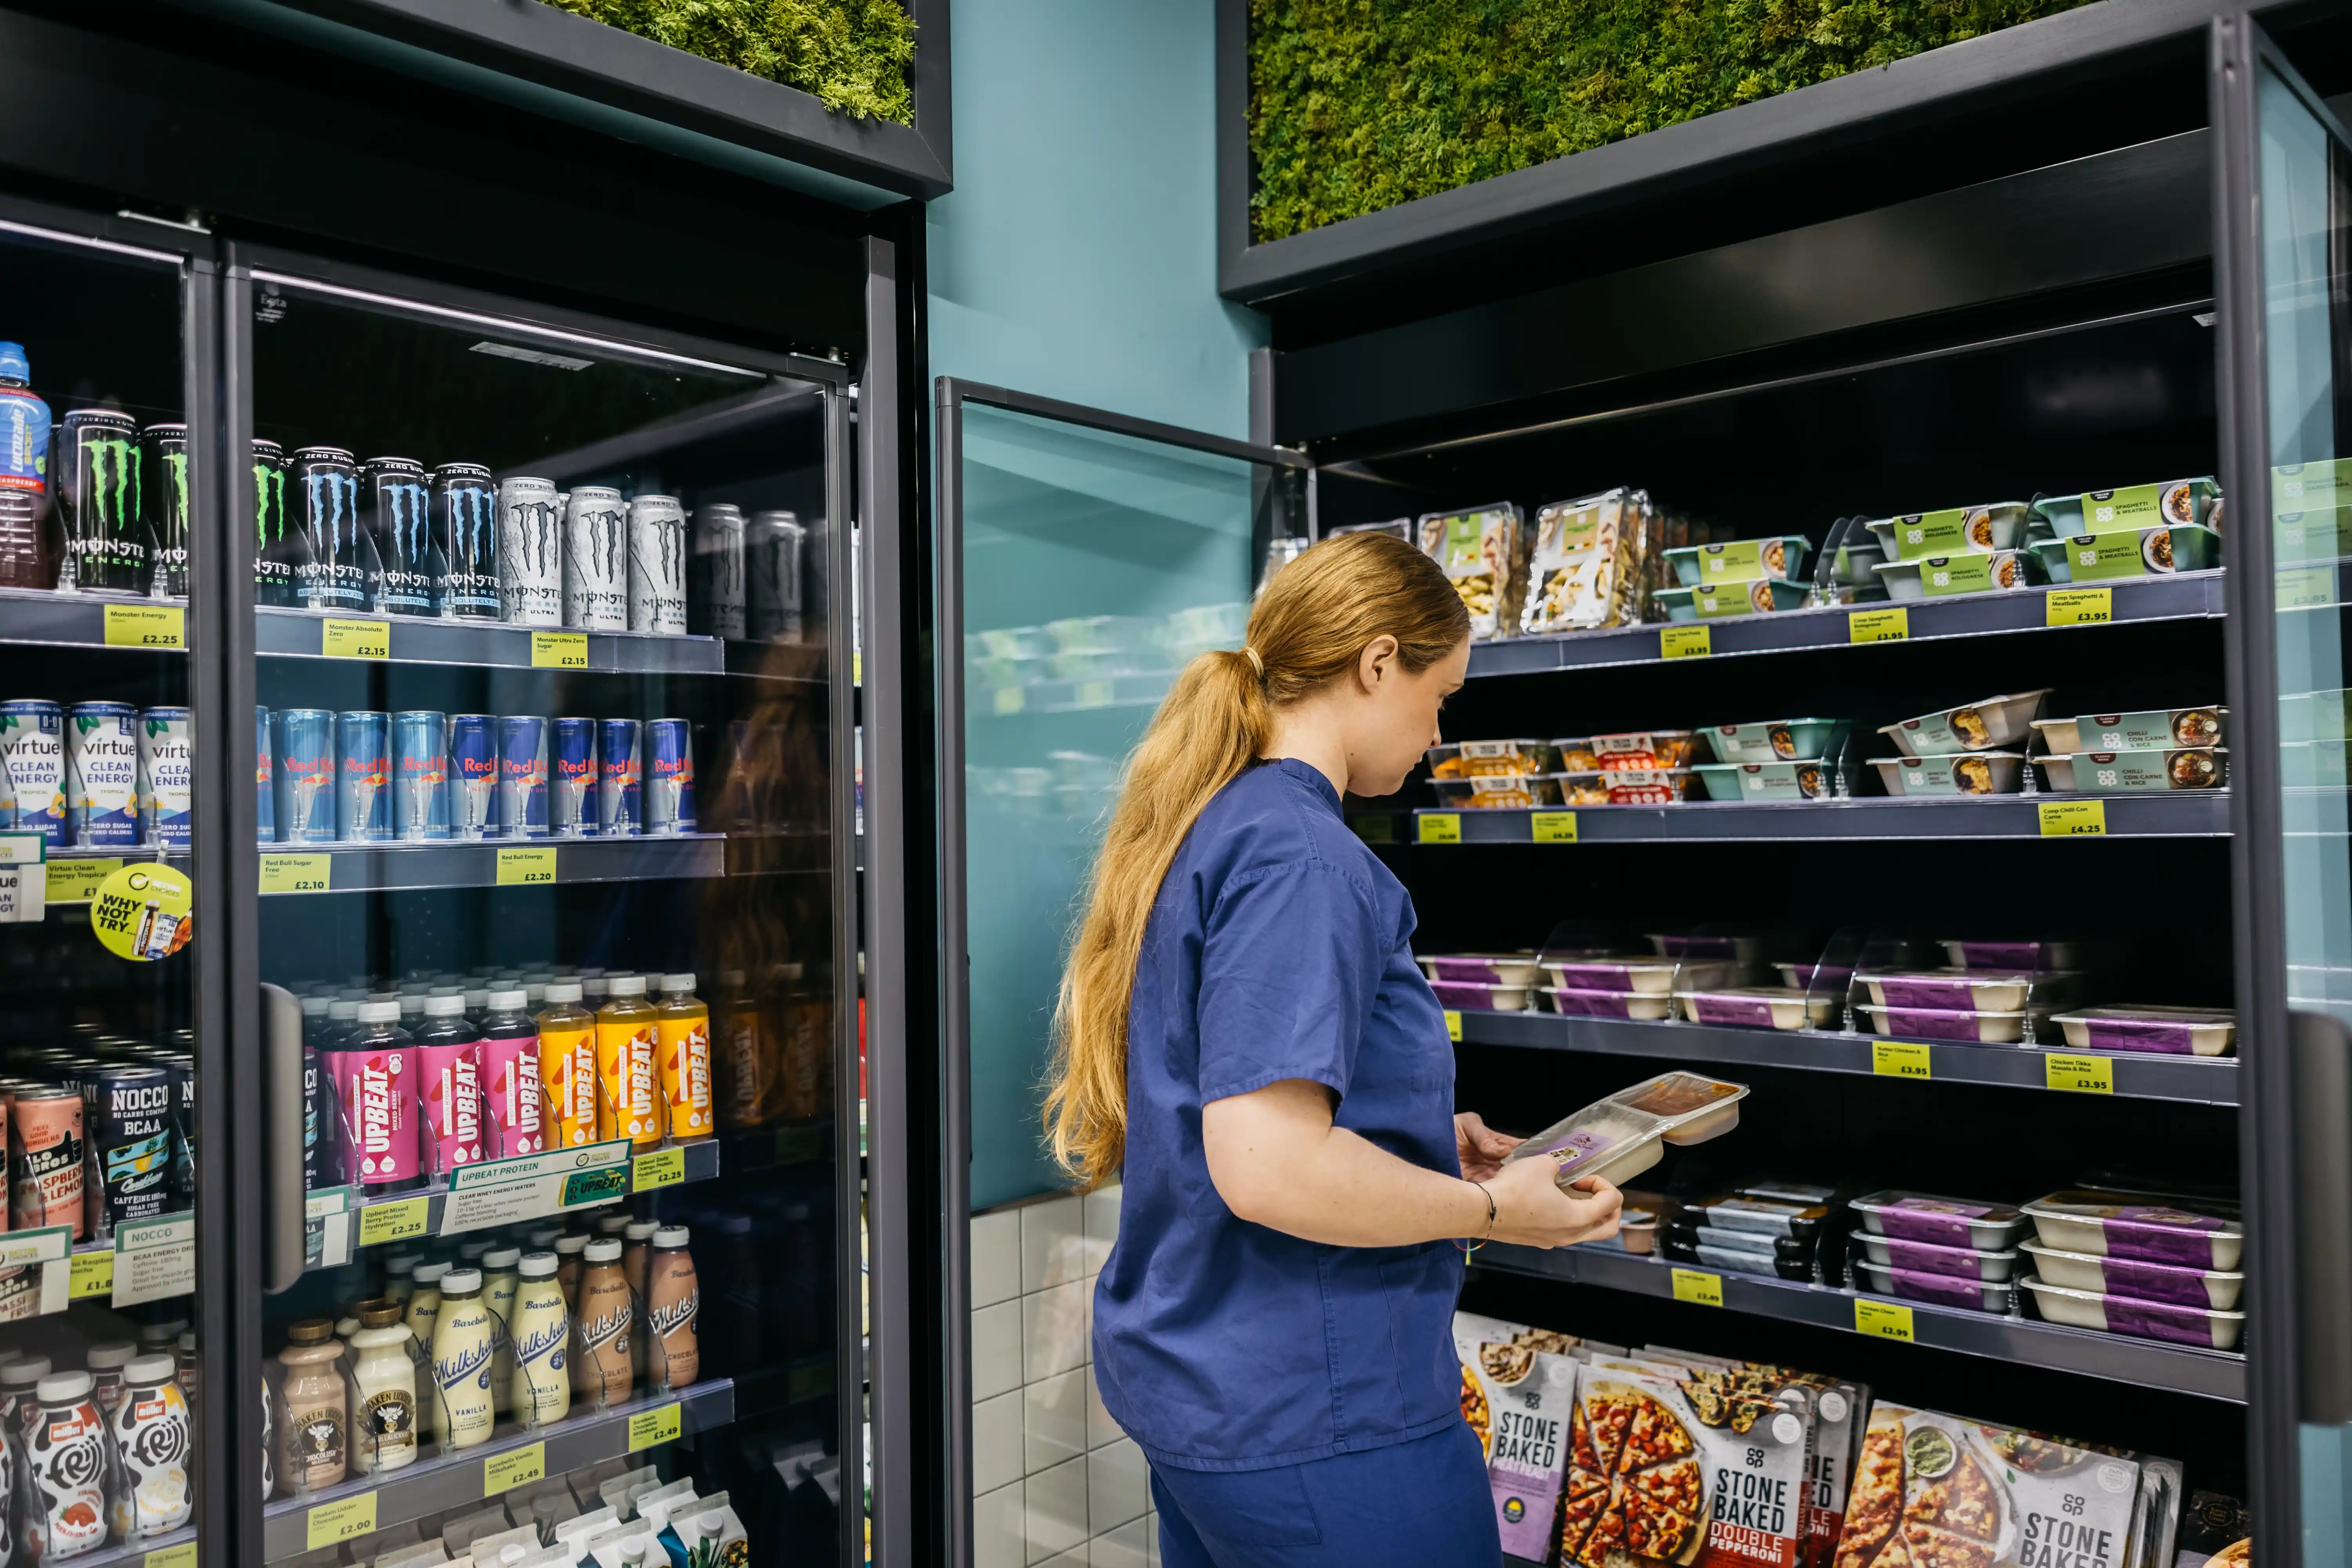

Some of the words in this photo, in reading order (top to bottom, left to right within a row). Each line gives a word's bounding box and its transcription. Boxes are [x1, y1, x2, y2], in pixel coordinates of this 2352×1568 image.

[2122, 505, 2157, 514] MEATBALLS
[2078, 612, 2108, 621] £3.95
[143, 635, 178, 644] £2.25
[1877, 632, 1903, 641] £3.95
[358, 647, 385, 656] £2.15
[562, 657, 585, 665] £2.15
[4, 739, 60, 755] virtue
[84, 739, 135, 756] virtue
[10, 762, 55, 771] CLEAN
[90, 762, 131, 771] CLEAN
[287, 757, 317, 772] Red
[346, 757, 377, 773] Red
[404, 757, 435, 770] Red
[465, 758, 492, 772] Red
[502, 759, 532, 773] Red
[558, 759, 586, 773] Red
[600, 759, 625, 773] Red
[655, 758, 682, 772] Red
[87, 774, 134, 784] ENERGY
[2071, 825, 2100, 833] £4.25
[295, 881, 325, 889] £2.10
[103, 893, 142, 912] WHY
[97, 904, 131, 921] NOT
[690, 1031, 709, 1108] UPBEAT
[1901, 1066, 1927, 1075] £3.95
[632, 1037, 652, 1116] UPBEAT
[576, 1044, 593, 1124] UPBEAT
[2077, 1080, 2107, 1089] £3.95
[111, 1085, 169, 1111] NOCCO
[519, 1051, 540, 1133] UPBEAT
[456, 1058, 478, 1142] UPBEAT
[123, 1110, 145, 1118] CARBS
[364, 1065, 390, 1153] UPBEAT
[123, 1118, 162, 1136] BCAA
[33, 1151, 53, 1164] LO
[462, 1169, 498, 1181] UPBEAT
[500, 1162, 539, 1175] PROTEIN
[658, 1171, 681, 1182] £2.25
[514, 1182, 536, 1191] WATERS
[580, 1176, 622, 1194] UPBEAT
[114, 1194, 151, 1205] CAFFEINE
[126, 1207, 160, 1218] CARBONATED
[365, 1208, 388, 1218] Upbeat
[390, 1205, 409, 1214] Mixed
[365, 1216, 382, 1225] Berry
[365, 1220, 396, 1230] Hydration
[132, 1228, 172, 1243] NOCCO
[391, 1223, 421, 1235] £2.25
[133, 1253, 152, 1261] BCAA
[153, 1248, 180, 1258] ENERGY
[133, 1259, 158, 1269] Caffeine
[161, 1256, 182, 1264] 180mg
[132, 1269, 150, 1277] Sugar
[132, 1276, 149, 1285] Great
[161, 1270, 183, 1278] muscle
[131, 1281, 162, 1292] Approved
[590, 1281, 626, 1295] Barebells
[525, 1296, 562, 1309] Barebells
[452, 1314, 488, 1328] Barebells
[456, 1403, 486, 1416] VANILLA
[633, 1415, 656, 1425] Barebells
[633, 1421, 658, 1432] Chocolate
[633, 1427, 658, 1437] Milkshake
[653, 1427, 678, 1439] £2.49
[1500, 1411, 1559, 1444] STONE
[1496, 1435, 1555, 1468] BAKED
[488, 1457, 514, 1469] Barebells
[515, 1451, 533, 1461] Vanilla
[488, 1463, 516, 1475] Milkshake
[512, 1469, 539, 1483] £2.49
[1716, 1468, 1788, 1507] STONE
[312, 1508, 336, 1519] Shaken
[337, 1503, 357, 1513] Udder
[1713, 1494, 1784, 1534] BAKED
[313, 1514, 344, 1526] Chocolate
[339, 1520, 371, 1535] £2.00
[1710, 1521, 1783, 1552] DOUBLE
[2025, 1512, 2112, 1559] STONE
[1710, 1536, 1782, 1564] PEPPERONI
